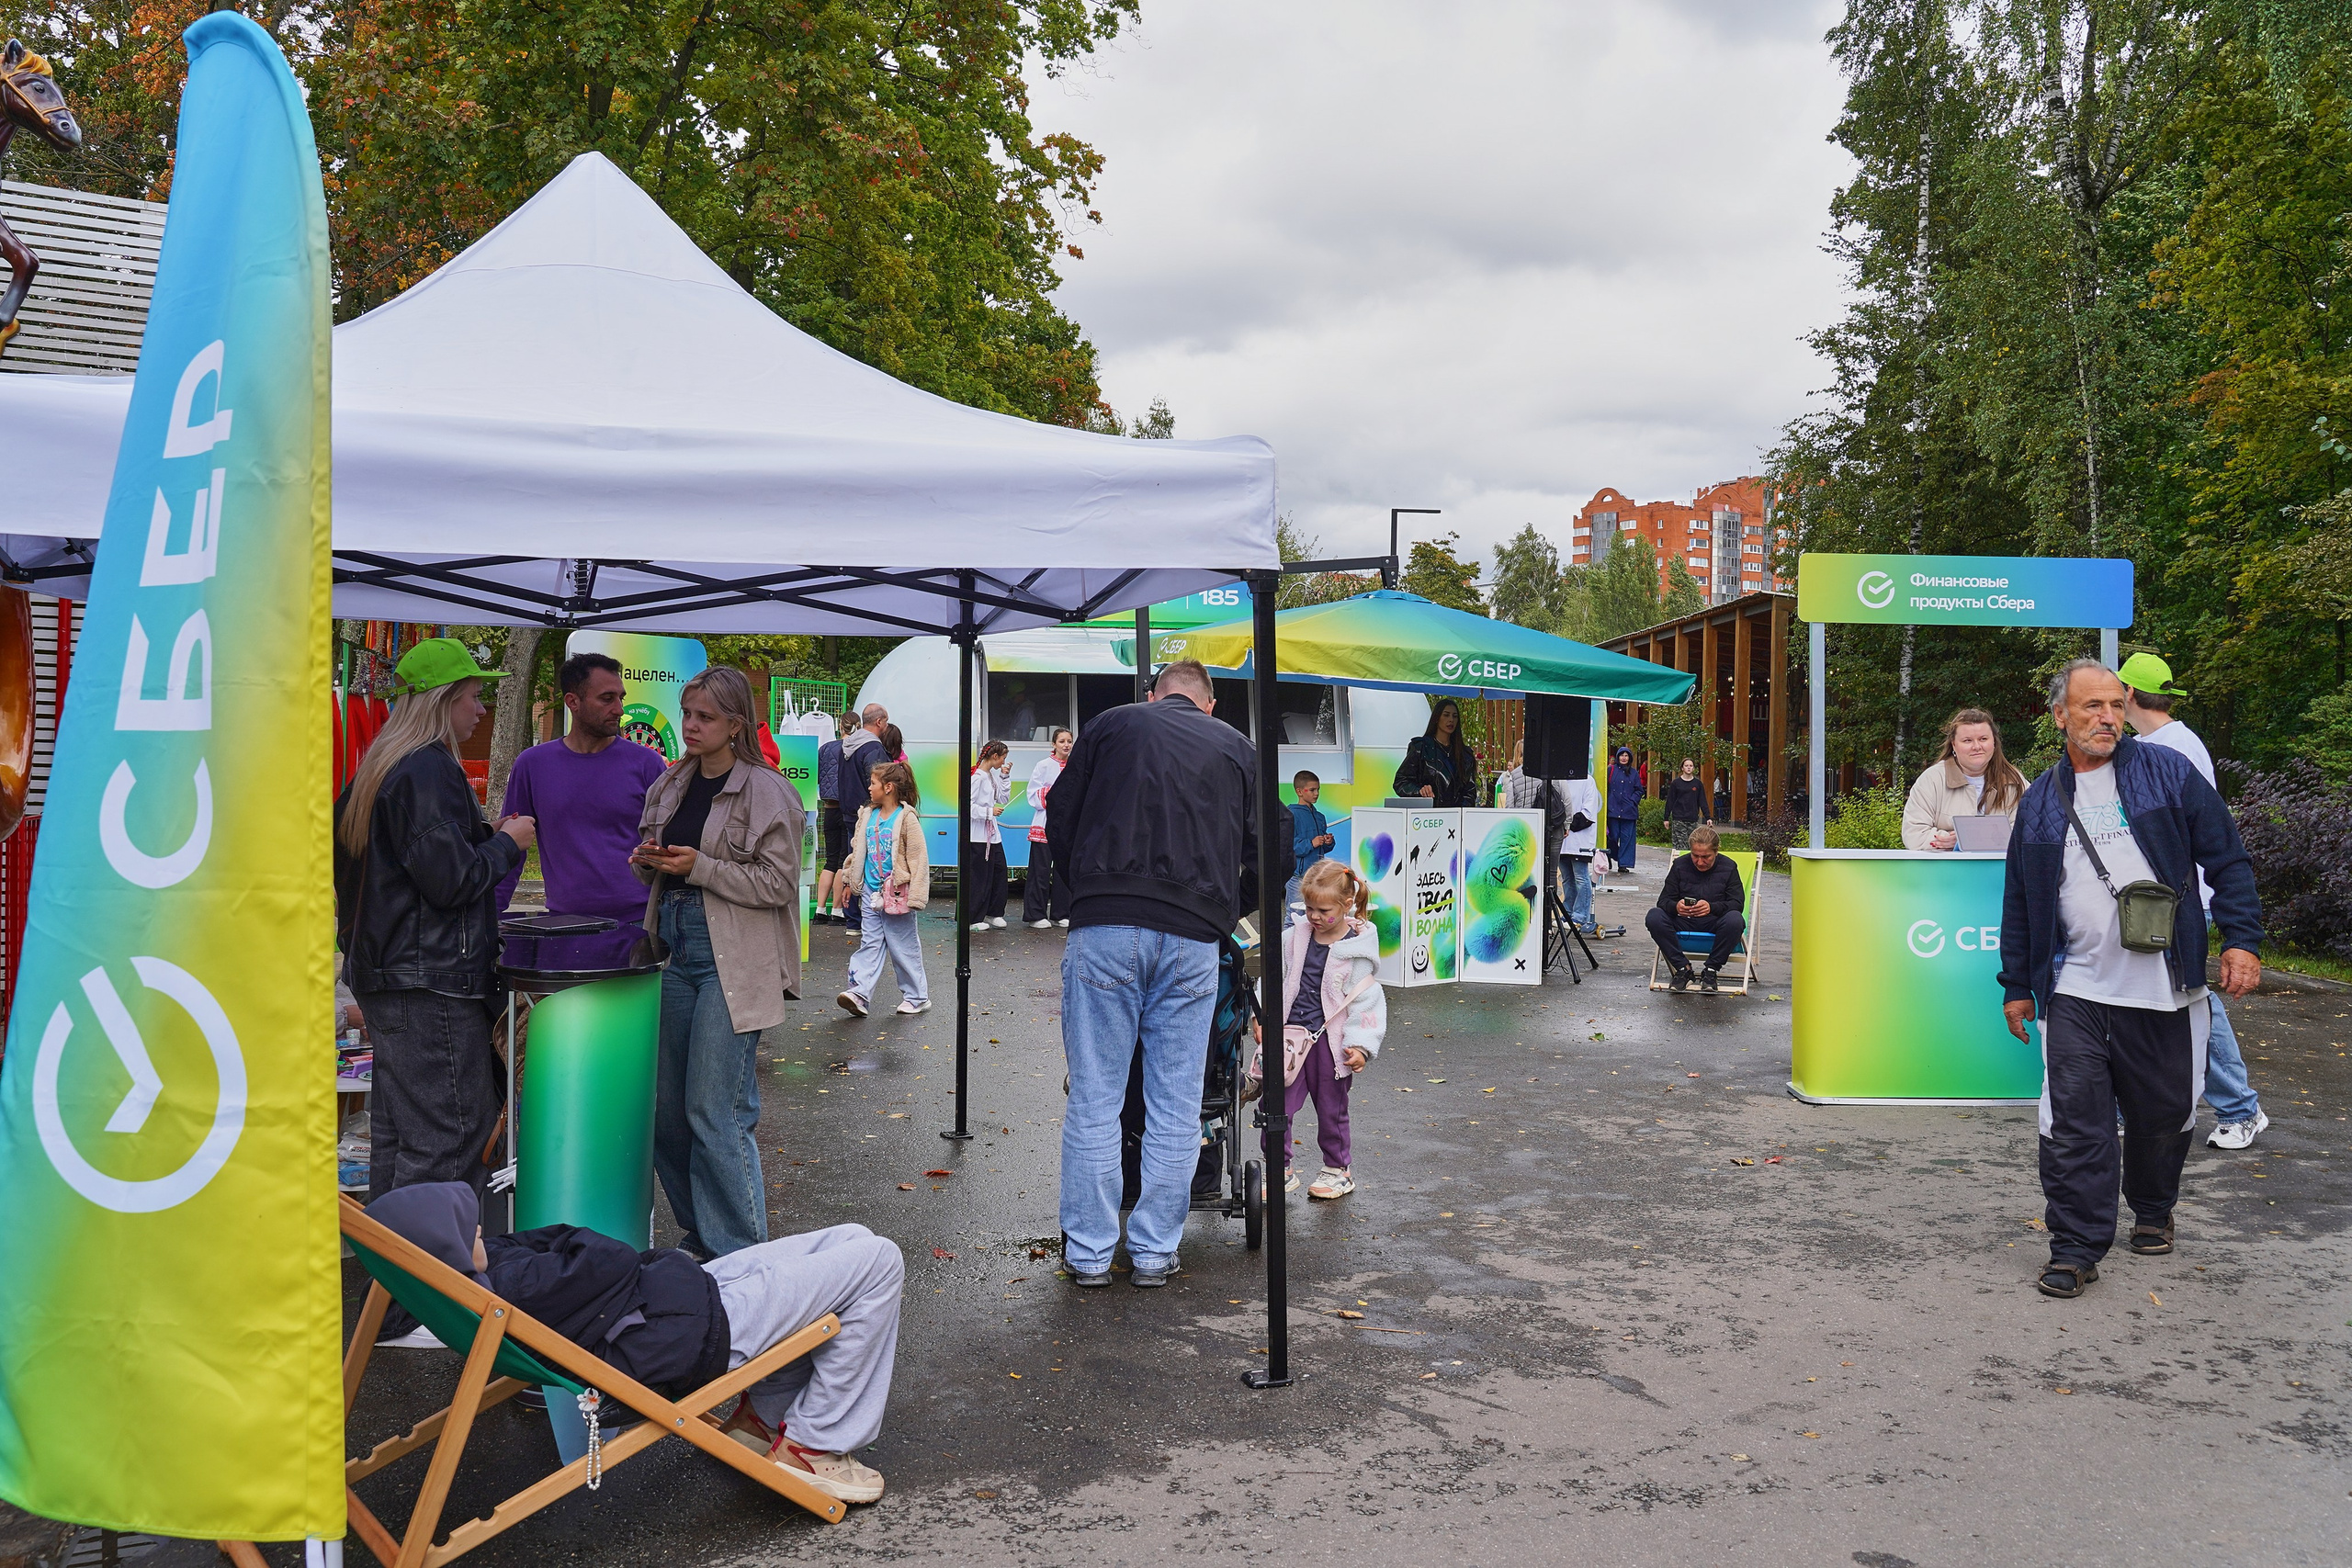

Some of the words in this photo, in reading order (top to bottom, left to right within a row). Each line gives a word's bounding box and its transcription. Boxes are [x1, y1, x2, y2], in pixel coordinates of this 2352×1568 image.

[1909, 572, 2009, 588] Финансовые
[1198, 589, 1239, 606] 185
[1910, 596, 1984, 611] продукты
[1986, 594, 2035, 613] Сбера
[99, 339, 232, 889] СБЕР
[1165, 638, 1187, 654] СБЕР
[619, 667, 689, 683] ацелен...
[1467, 660, 1521, 681] СБЕР
[781, 767, 809, 780] 185
[1422, 818, 1443, 829] СБЕР
[1416, 872, 1445, 888] ЗДЕСЬ
[1416, 917, 1453, 938] ВОЛНА
[1955, 926, 2001, 951] СБ
